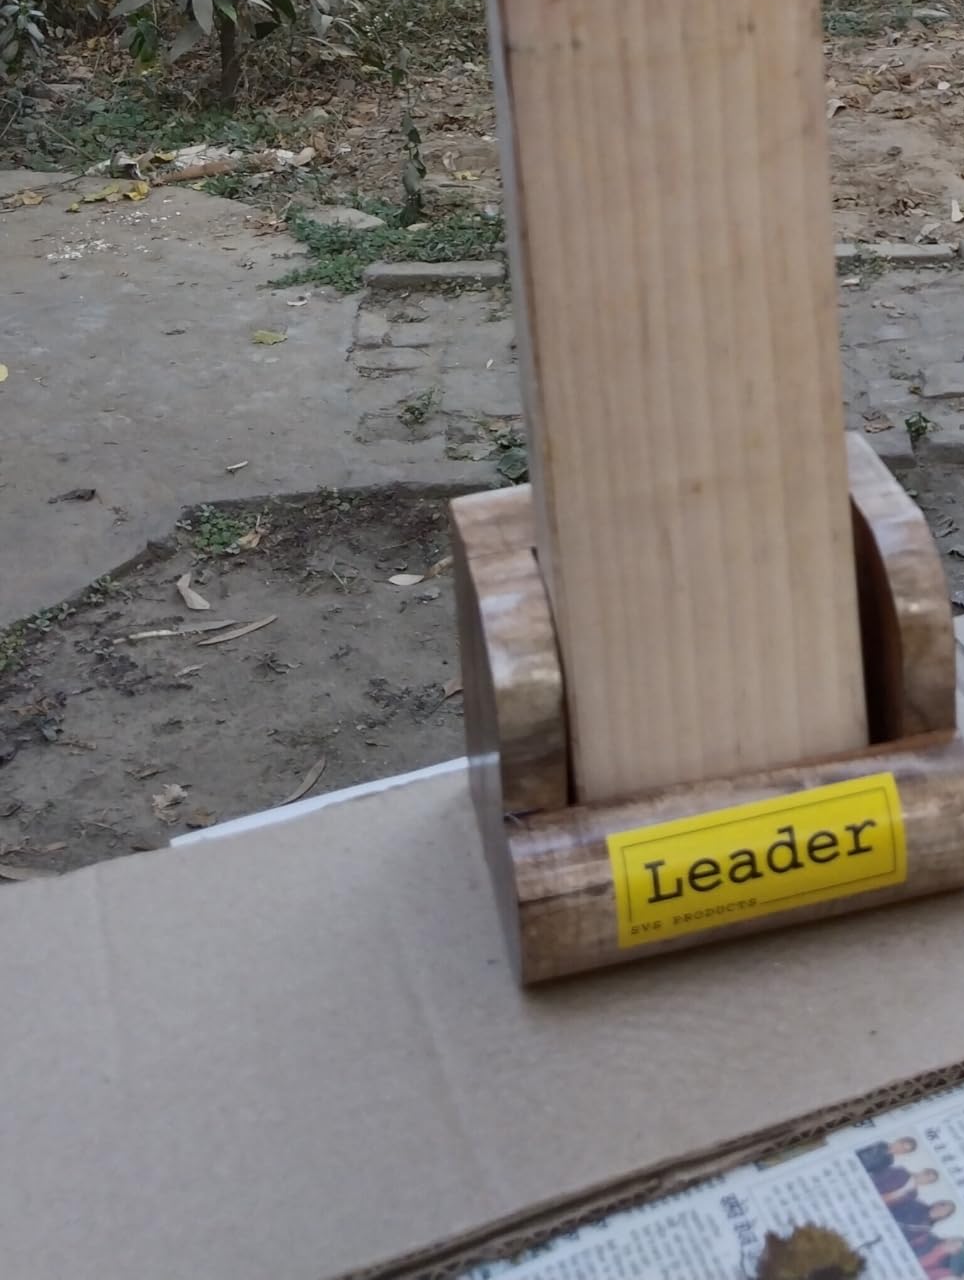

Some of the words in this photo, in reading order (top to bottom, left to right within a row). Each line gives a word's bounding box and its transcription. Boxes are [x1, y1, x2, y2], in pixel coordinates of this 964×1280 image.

[645, 819, 877, 903] Leader
[630, 920, 663, 936] SVS
[672, 897, 758, 926] PRODUCTS
